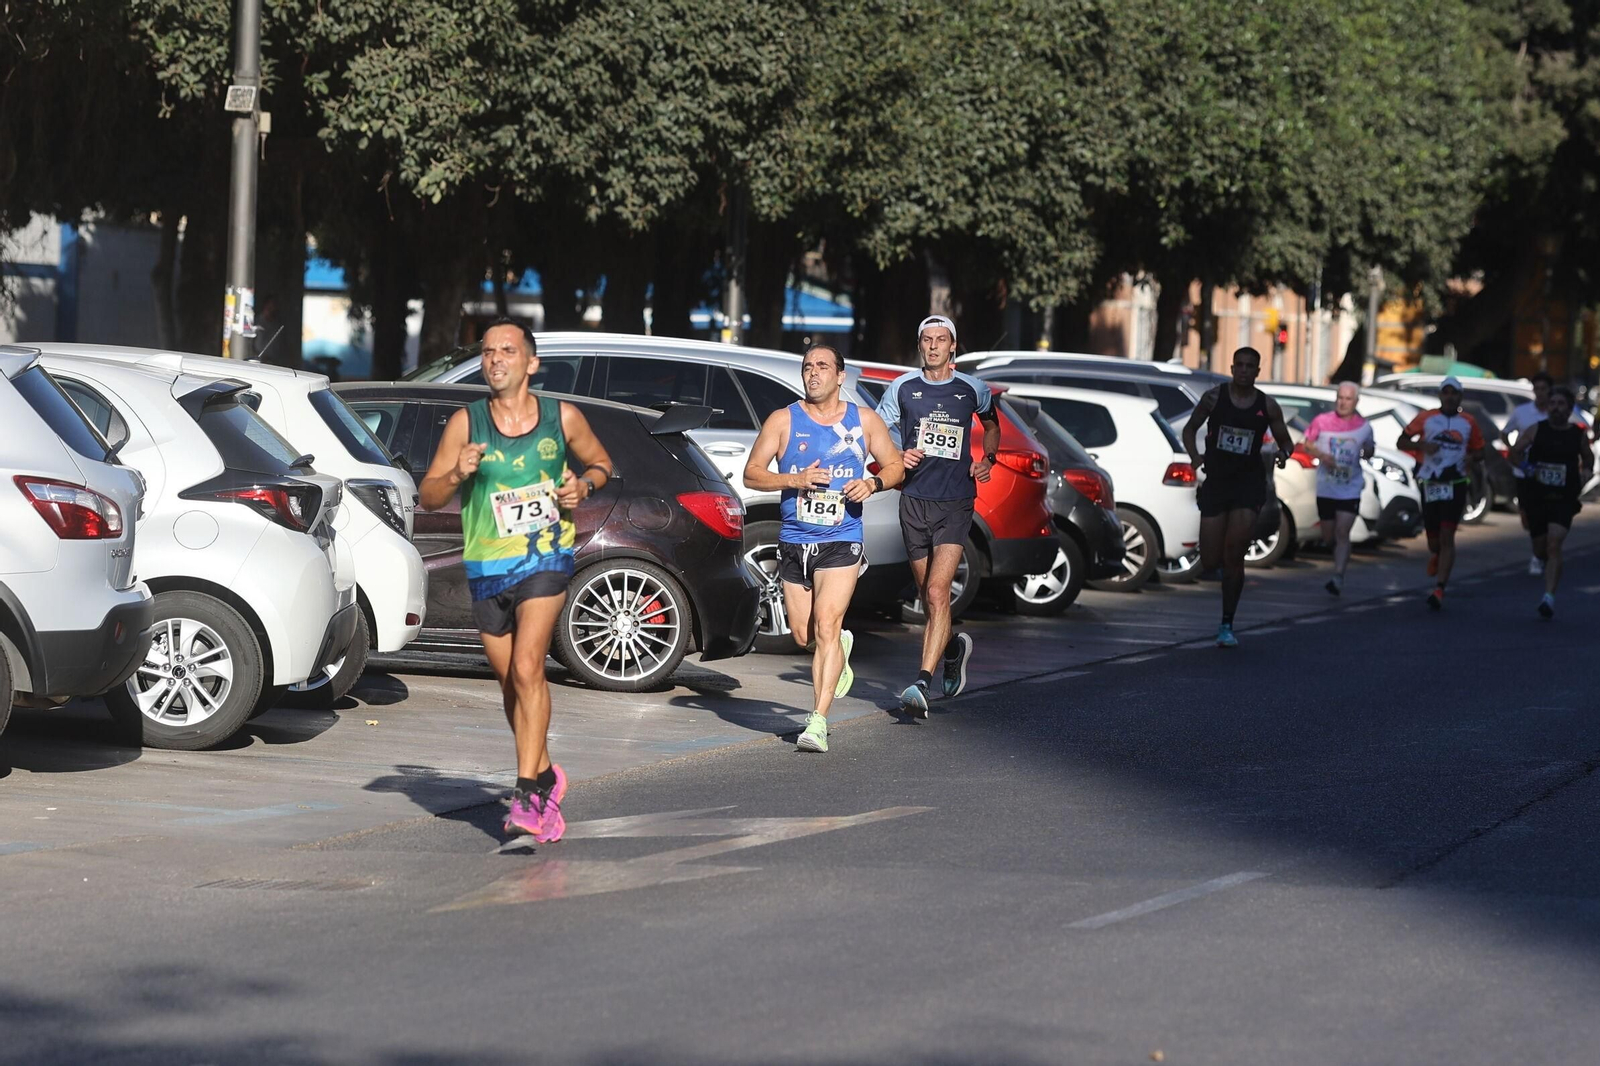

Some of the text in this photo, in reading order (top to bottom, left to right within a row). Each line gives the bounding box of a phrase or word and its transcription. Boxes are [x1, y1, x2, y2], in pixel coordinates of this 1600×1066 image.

[924, 432, 957, 448] 393
[1227, 435, 1243, 446] 41
[510, 500, 543, 521] 73
[803, 500, 837, 516] 184
